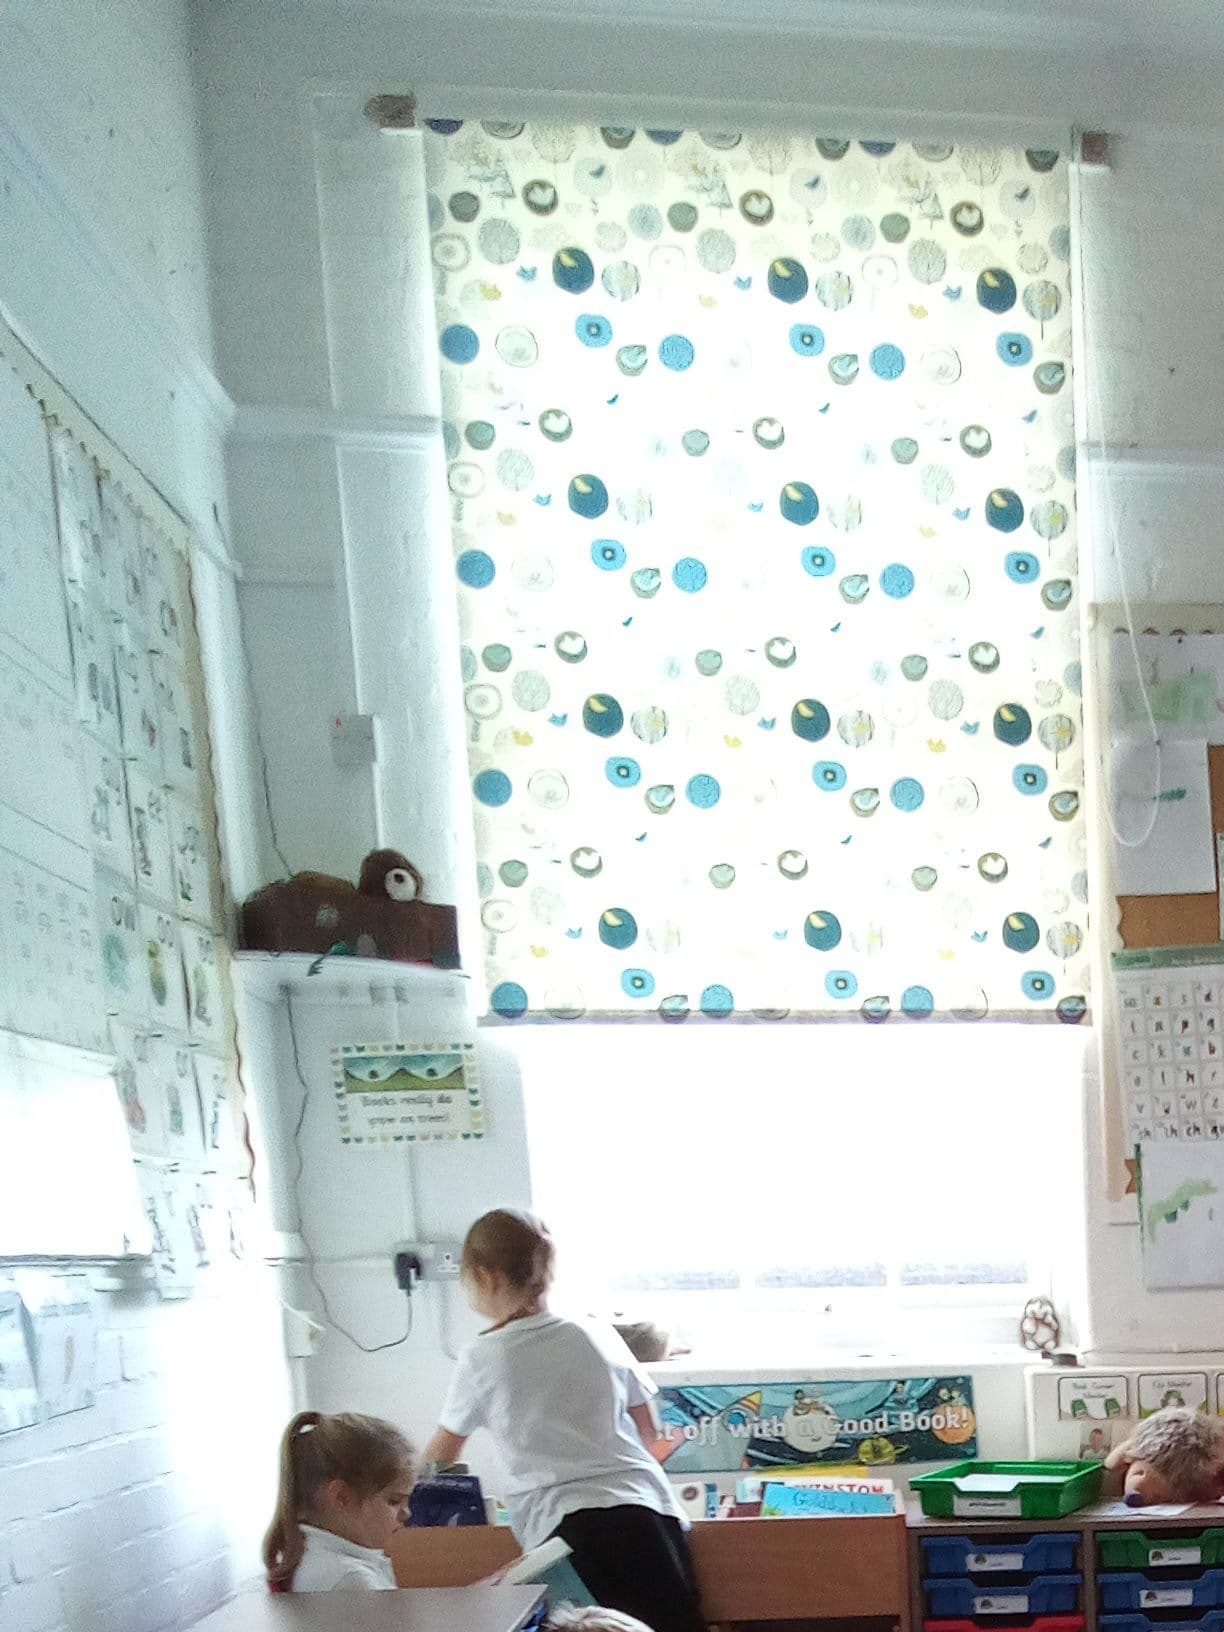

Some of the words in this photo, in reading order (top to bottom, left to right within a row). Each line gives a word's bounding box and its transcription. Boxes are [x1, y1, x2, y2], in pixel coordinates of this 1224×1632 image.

[683, 1415, 722, 1446] off
[727, 1414, 787, 1439] with
[898, 1406, 970, 1432] Book!
